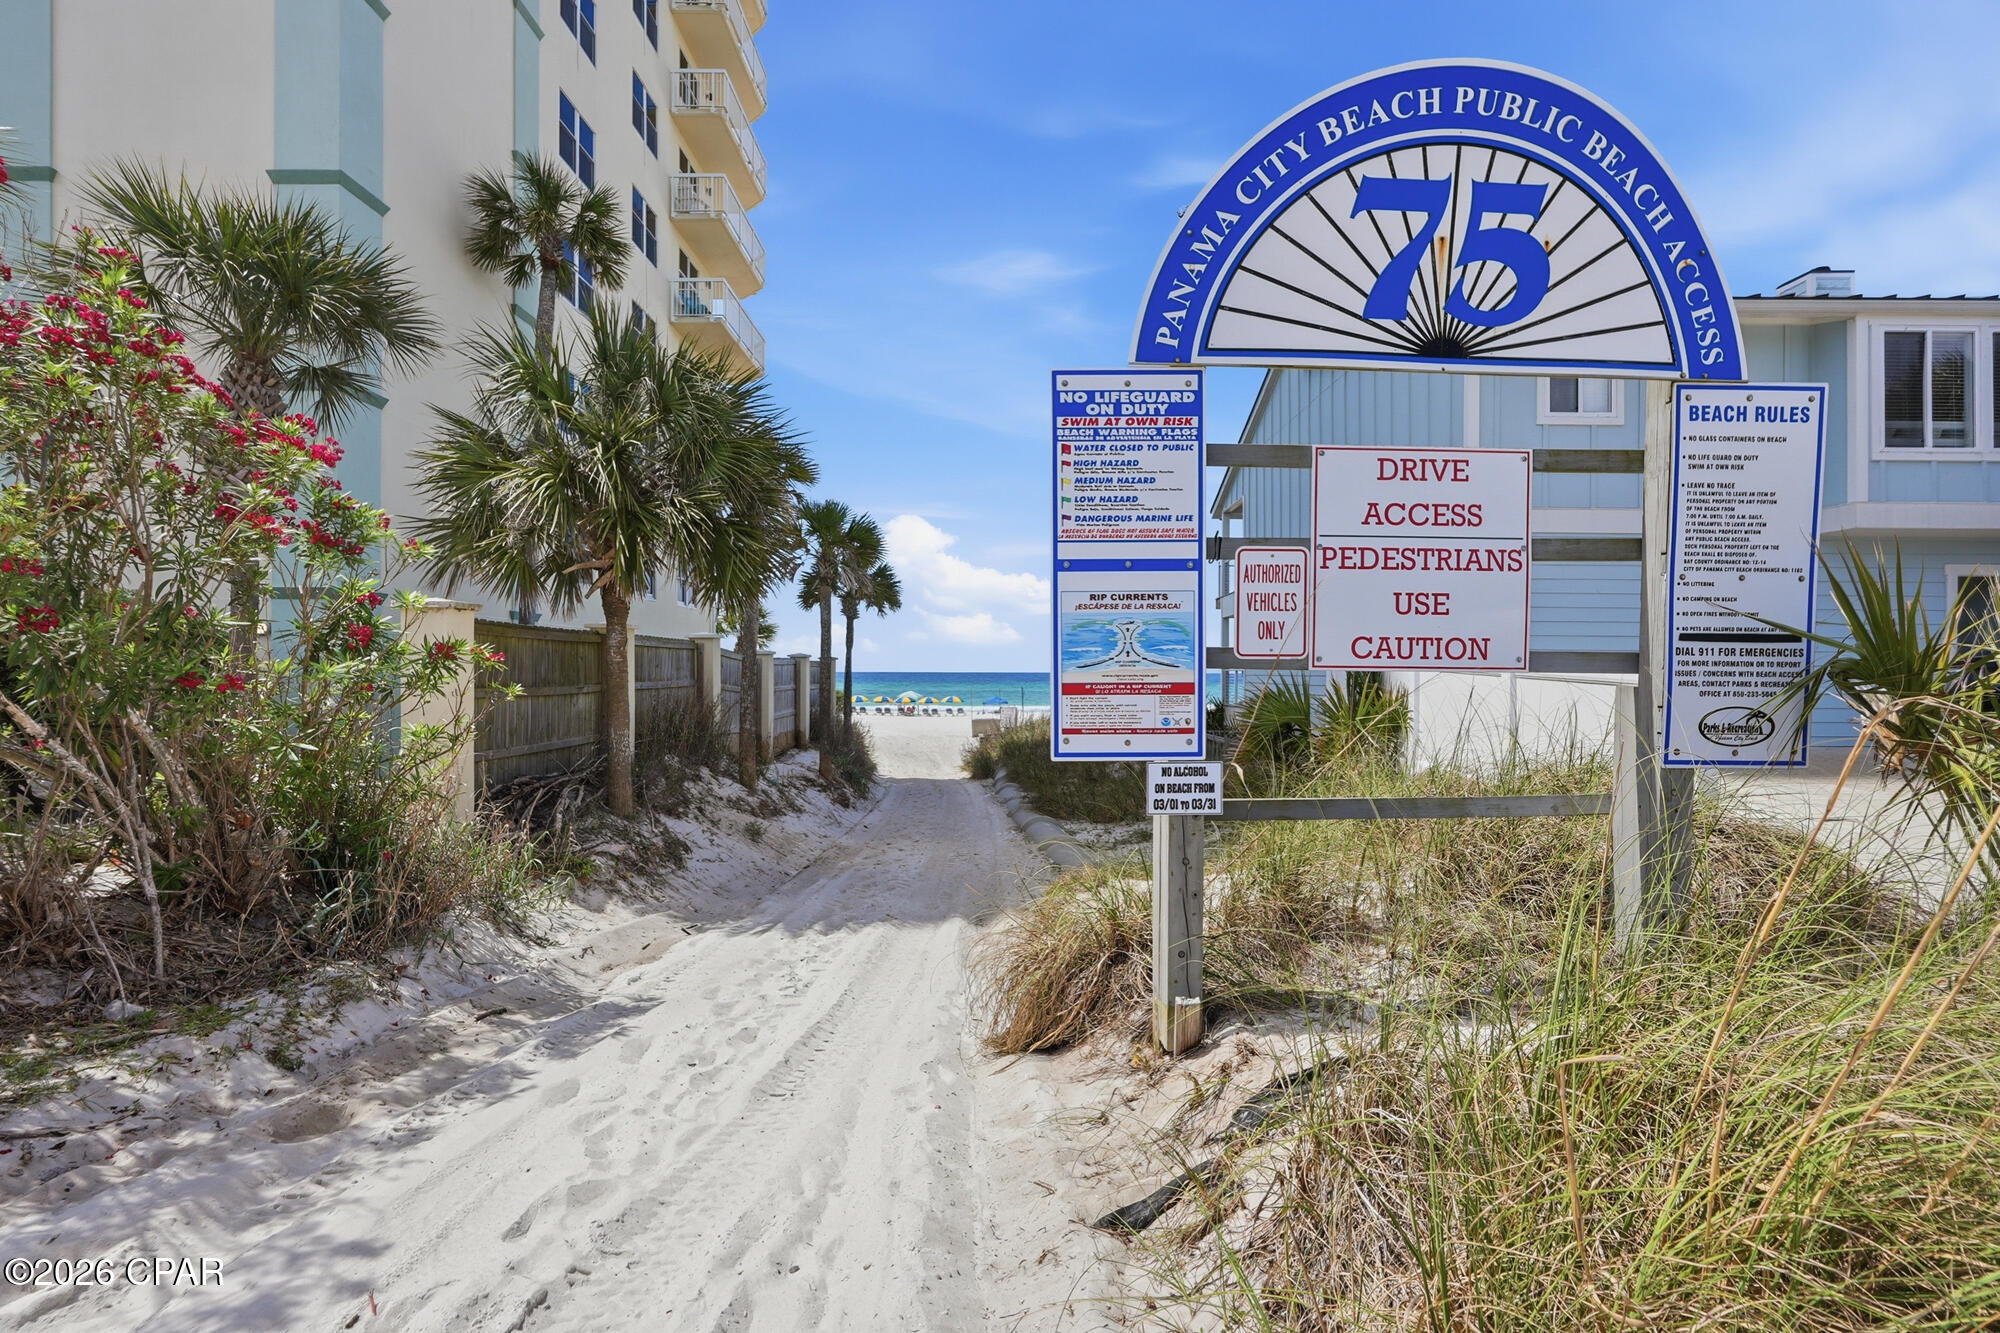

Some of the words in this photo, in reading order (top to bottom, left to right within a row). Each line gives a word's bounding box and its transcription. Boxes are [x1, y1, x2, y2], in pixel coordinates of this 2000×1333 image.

[1154, 210, 1240, 349] PANAMA
[1235, 132, 1312, 206] CITY
[1317, 87, 1442, 147] BEACH
[1455, 87, 1583, 143] PUBLIC
[1582, 129, 1674, 227] BEACH
[1663, 240, 1724, 366] ACCESS
[1351, 173, 1551, 327] 75
[1060, 392, 1087, 403] NO
[1095, 392, 1195, 403] LIFEGUARD
[1086, 404, 1114, 415] ON
[1122, 404, 1168, 415] DUTY
[1689, 405, 1747, 422] BEACH
[1755, 406, 1810, 423] RULES
[1062, 418, 1099, 426] SWIM
[1104, 418, 1121, 426] AT
[1125, 418, 1158, 426] OWN
[1163, 418, 1193, 426] RISK
[1377, 458, 1469, 482] DRIVE
[1362, 502, 1482, 526] ACCESS
[1320, 546, 1522, 572] PEDESTRIANS
[1244, 564, 1300, 584] AUTHORIZED
[1075, 602, 1119, 611] ¡ESCÁPESE
[1247, 592, 1297, 612] VEHICLES
[1394, 592, 1450, 616] USE
[1258, 621, 1285, 640] ONLY
[1351, 636, 1490, 660] CAUTION
[1675, 647, 1695, 656] DIAL
[1699, 647, 1715, 656] 911
[1718, 648, 1736, 657] FOR
[1740, 648, 1804, 658] EMERGENCIES
[1704, 723, 1720, 733] Parks
[1161, 767, 1172, 776] NO
[1174, 767, 1208, 776] ALCOHOL
[1155, 784, 1165, 793] ON
[1167, 784, 1192, 793] BEACH
[1194, 783, 1215, 793] FROM
[1154, 799, 1178, 810] 03/01
[1191, 799, 1216, 810] 03/31
